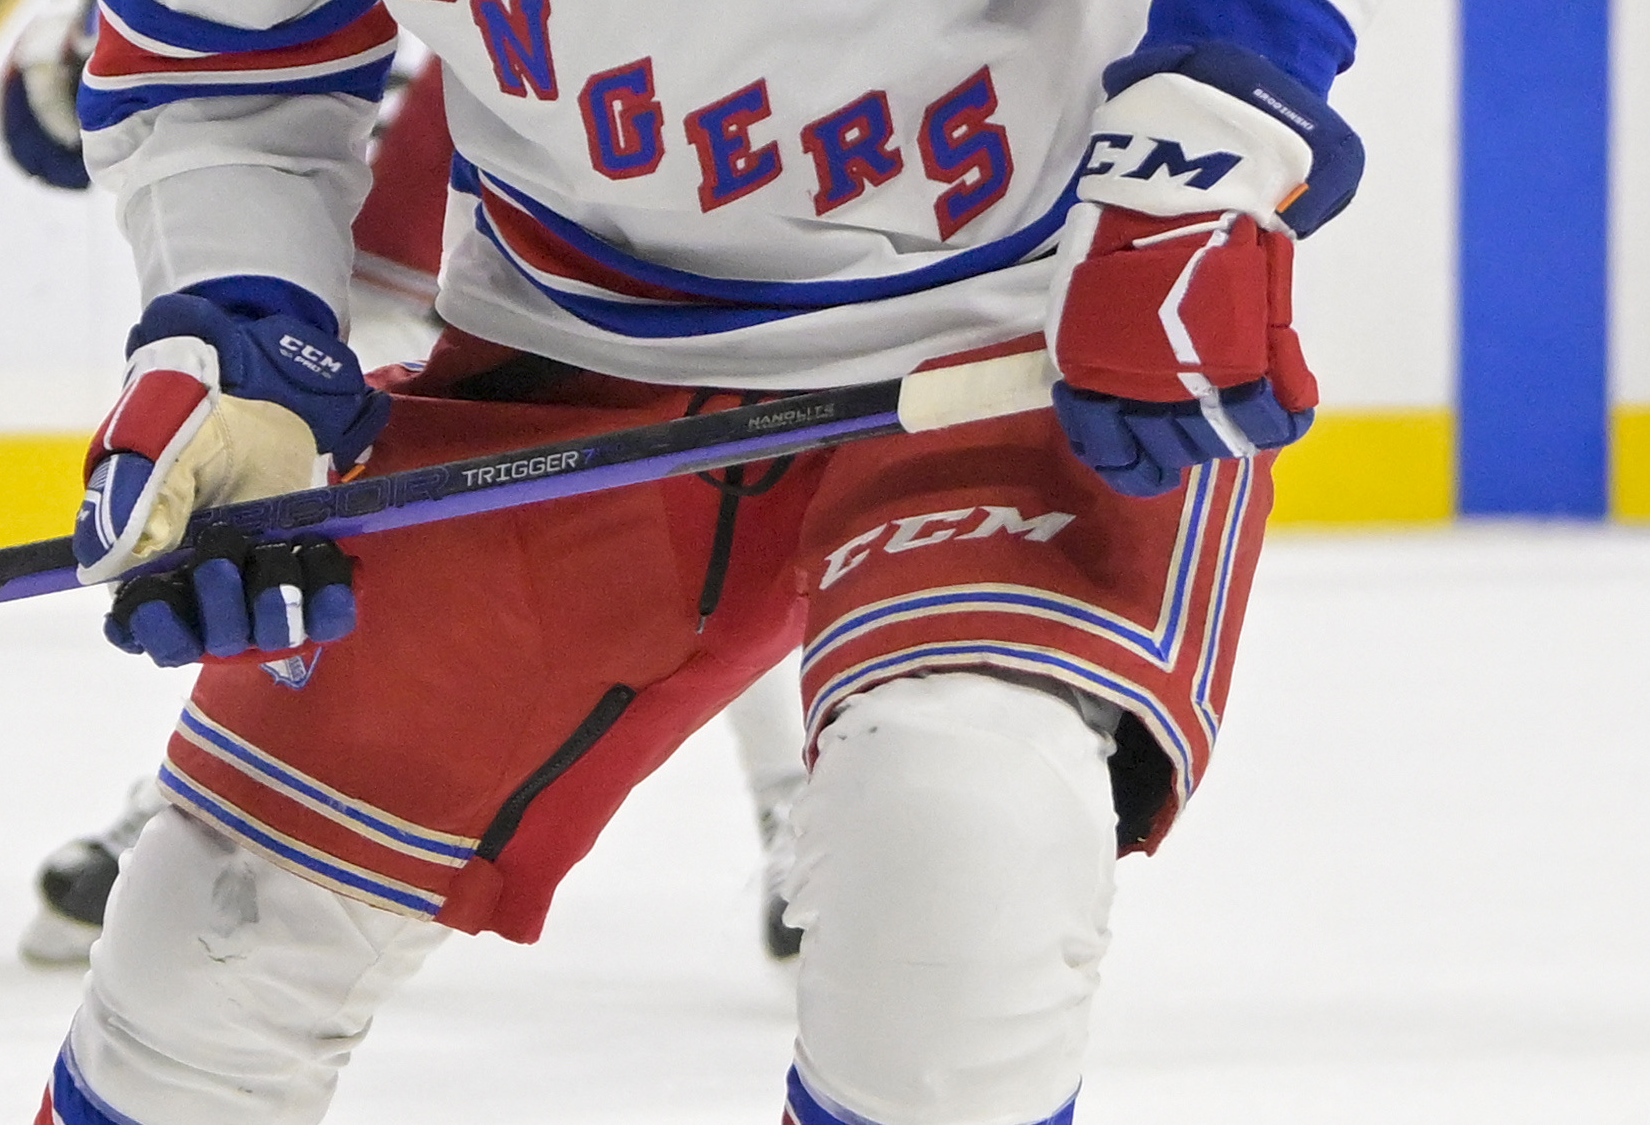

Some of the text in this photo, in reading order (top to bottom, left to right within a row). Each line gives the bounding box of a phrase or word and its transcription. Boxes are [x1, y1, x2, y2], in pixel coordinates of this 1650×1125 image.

[279, 334, 343, 373] CCM
[461, 449, 580, 488] TRIGGER
[582, 448, 597, 465] 7
[819, 505, 1077, 591] CCM
